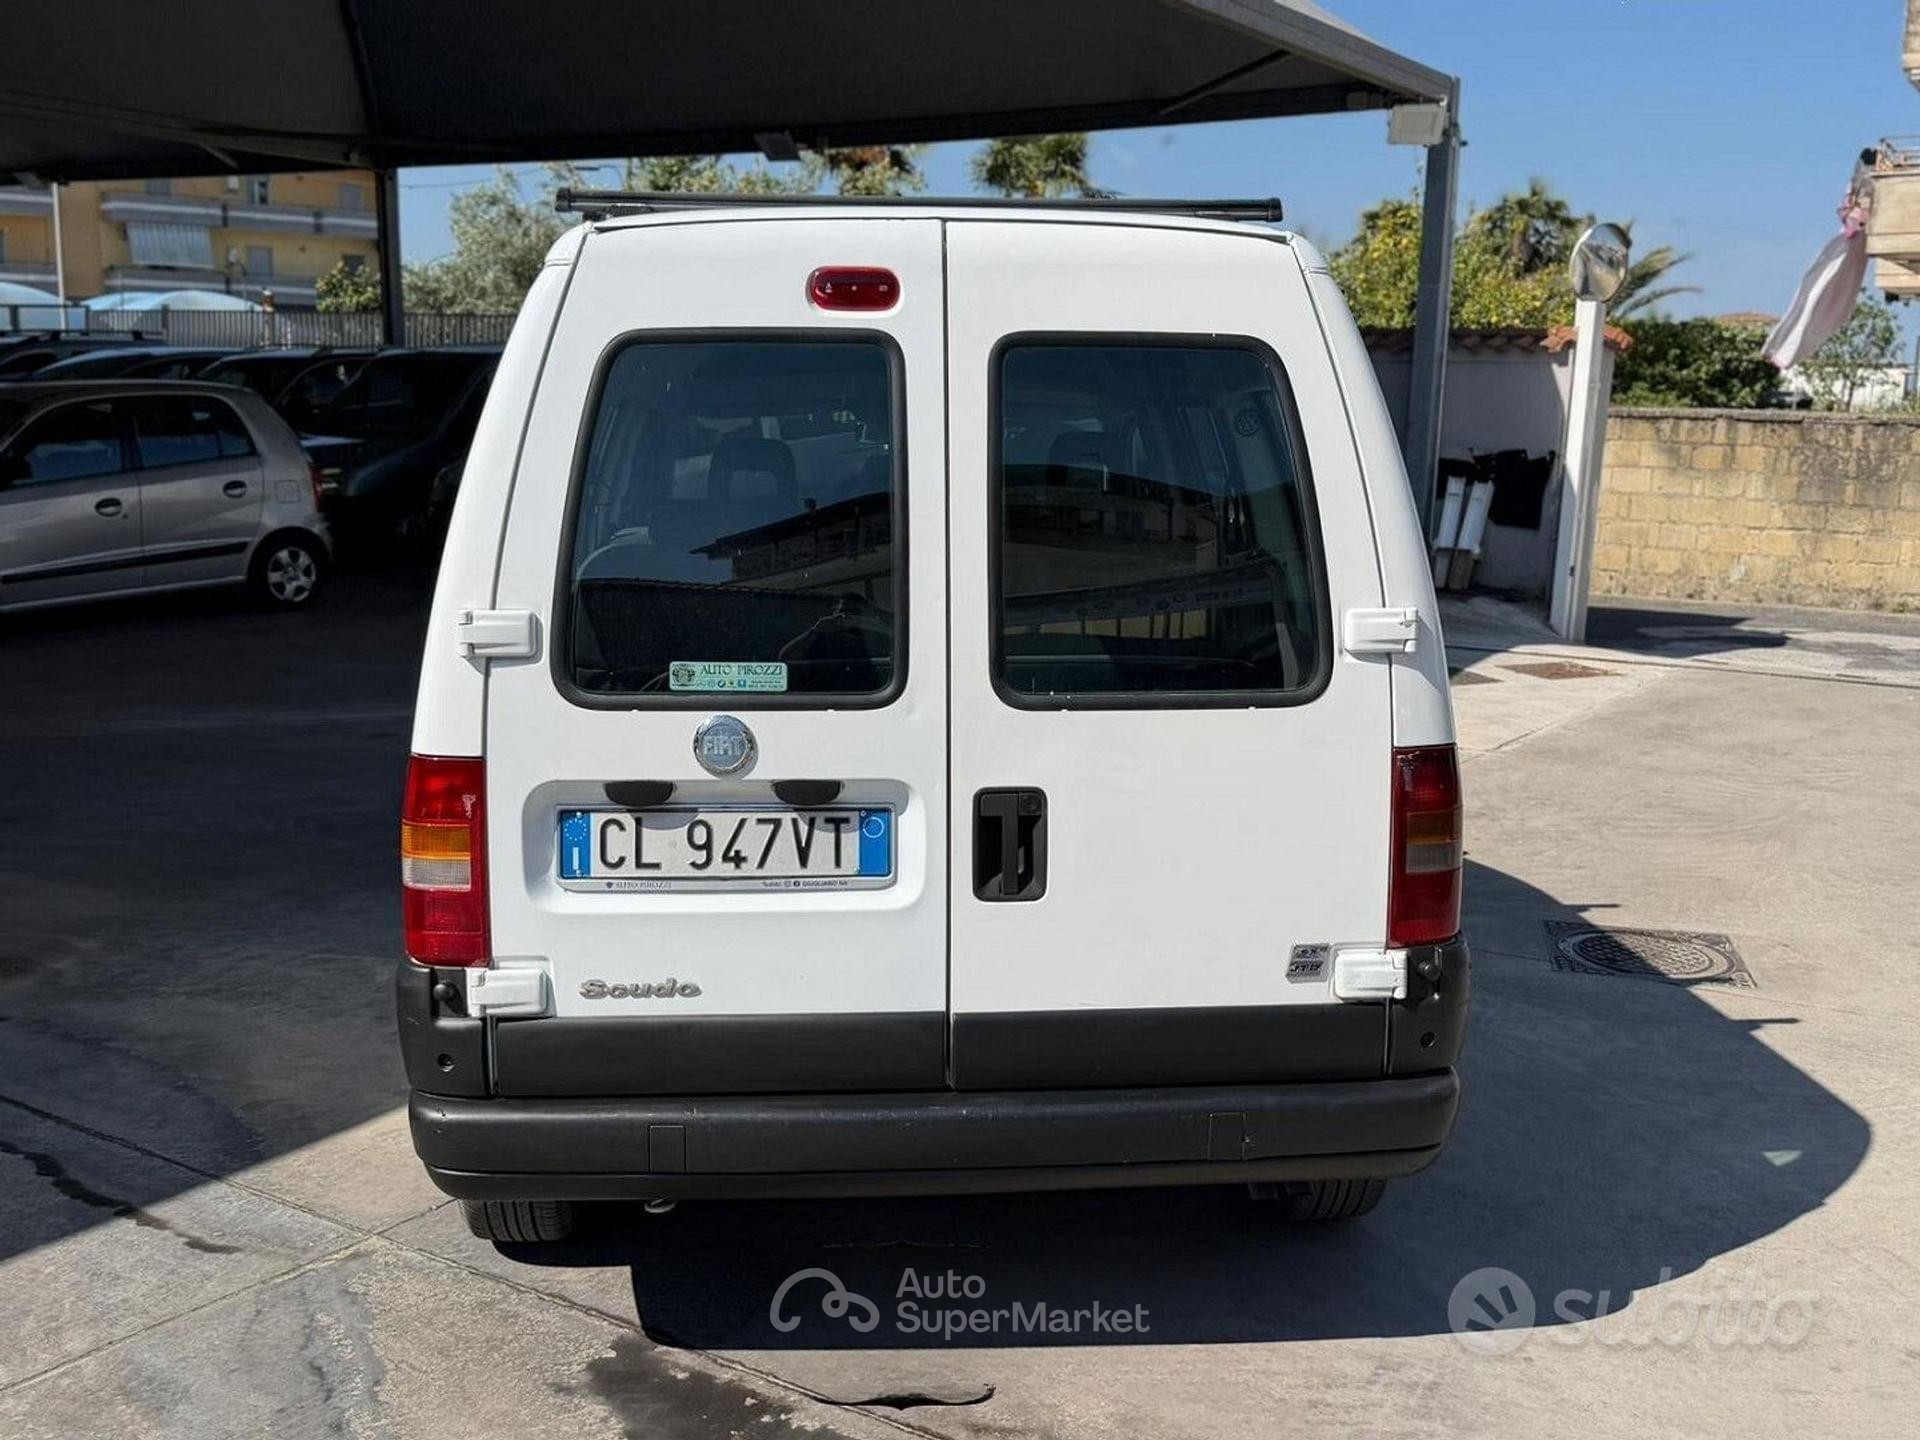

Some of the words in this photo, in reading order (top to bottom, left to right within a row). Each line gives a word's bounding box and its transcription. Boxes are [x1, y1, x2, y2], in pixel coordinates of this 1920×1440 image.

[701, 664, 732, 676] AUTO
[737, 664, 783, 676] PIROZZI
[599, 817, 662, 871] CL
[686, 816, 850, 870] 947VT
[579, 977, 702, 999] Scudo
